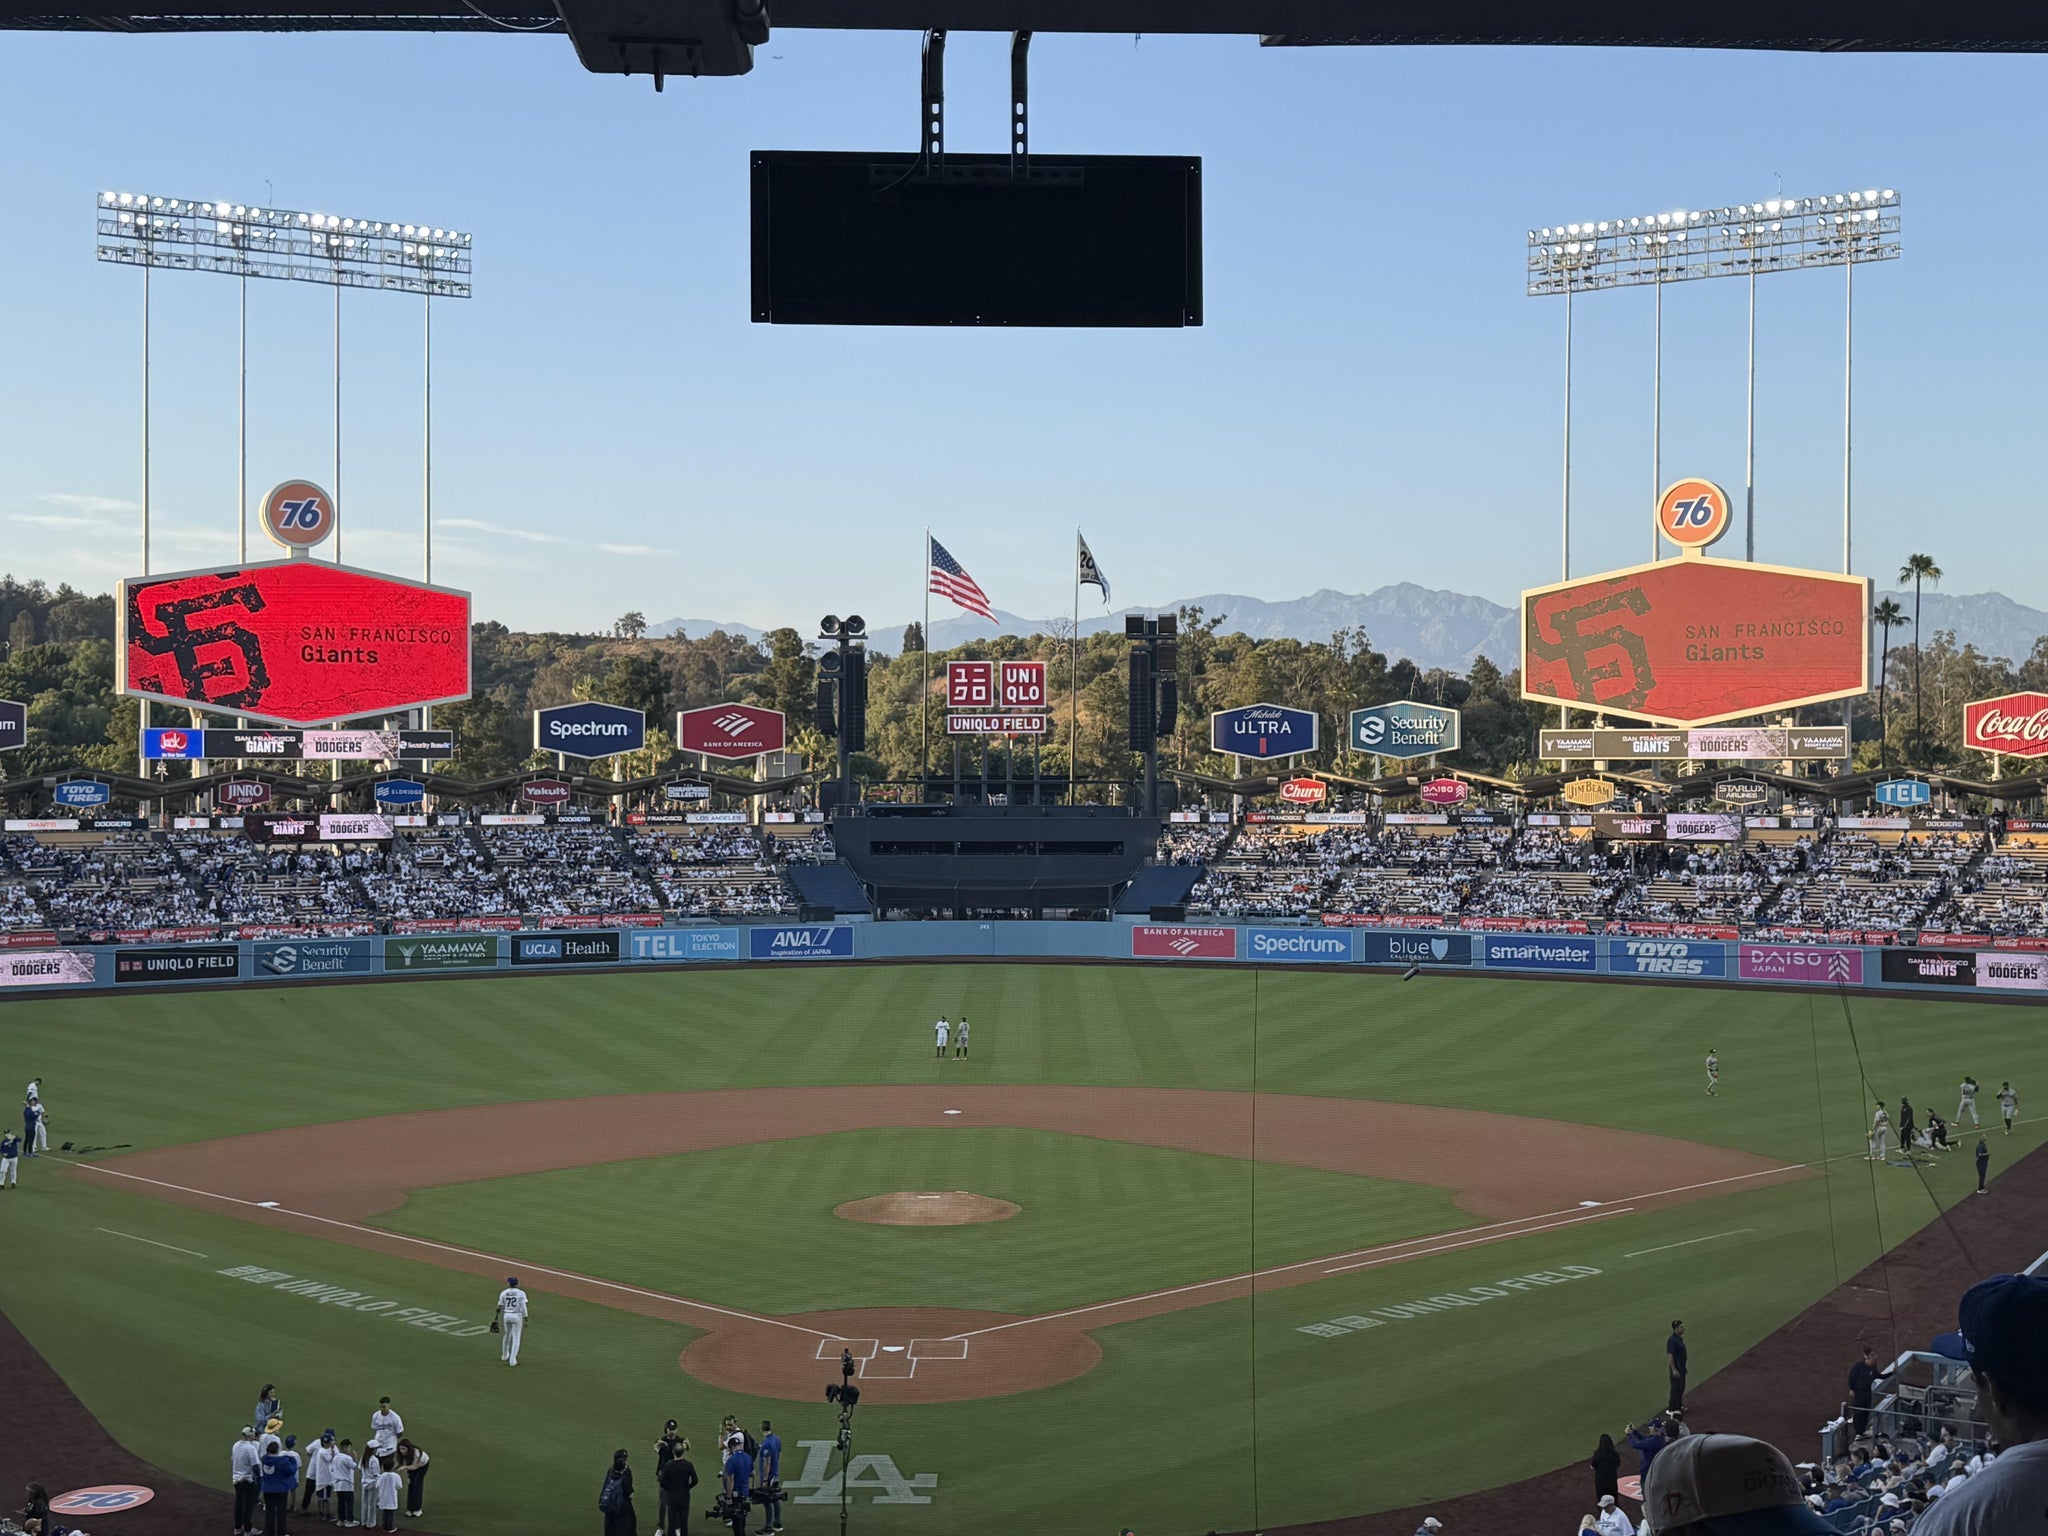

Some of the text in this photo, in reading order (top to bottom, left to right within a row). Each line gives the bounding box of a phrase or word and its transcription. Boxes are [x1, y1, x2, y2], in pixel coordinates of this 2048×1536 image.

[278, 497, 323, 530] 76
[1671, 494, 1714, 529] 76
[301, 626, 451, 644] SAN FRANCISCO
[1685, 621, 1845, 640] SAN FRANCISCO
[301, 644, 379, 664] Giants
[1686, 643, 1765, 662] Giants
[1007, 668, 1037, 683] UNI
[1007, 686, 1040, 703] QLO
[1244, 709, 1283, 720] Michelob
[550, 720, 628, 739] Spectrum
[953, 718, 1040, 732] UNIQLO FIELD
[1234, 721, 1292, 734] ULTRA
[1391, 716, 1448, 732] Security
[160, 733, 187, 749] Jack
[1391, 731, 1440, 745] Benefit
[246, 741, 284, 753] GIANTS
[315, 741, 362, 753] DODGERS
[1633, 741, 1670, 753] GIANTS
[1700, 740, 1748, 752] DODGERS
[62, 785, 95, 794] TOYO
[227, 784, 263, 800] JINRO
[525, 787, 568, 796] Yakult
[1282, 784, 1323, 798] Churu
[1568, 782, 1610, 799] JIM BEAM
[1719, 785, 1765, 793] STARLUX
[1882, 784, 1923, 801] TEL
[67, 793, 104, 802] TIRES
[273, 825, 304, 835] GIANTS
[330, 824, 368, 834] DODGERS
[1621, 823, 1652, 834] GIANTS
[1677, 824, 1716, 834] DODGERS
[691, 934, 720, 942] TOKYO
[772, 931, 811, 947] ANA
[1254, 934, 1340, 954] Spectrum
[302, 945, 351, 957] Security
[525, 944, 557, 954] UCLA
[566, 941, 610, 955] Health
[634, 935, 683, 957] TEL
[692, 942, 736, 950] ELECTRON
[1390, 937, 1429, 954] blue
[1626, 942, 1688, 958] TOYO
[771, 949, 803, 957] Inspiration
[1752, 950, 1821, 966] DAISO
[147, 958, 193, 971] UNIQLO
[198, 956, 234, 968] FIELD
[302, 958, 344, 970] Benefit
[1636, 957, 1703, 974] TIRES
[1752, 965, 1785, 973] JAPAN
[1926, 958, 1968, 966] FRANCISCO
[12, 963, 60, 976] DODGERS
[1919, 964, 1957, 977] GIANTS
[1988, 966, 2038, 980] DODGERS
[1370, 1265, 1603, 1319] UNIQLO FIELD
[274, 1279, 490, 1337] UNIQLO FIELD
[505, 1297, 517, 1307] 72
[781, 1440, 938, 1504] LA
[55, 1490, 146, 1509] 76
